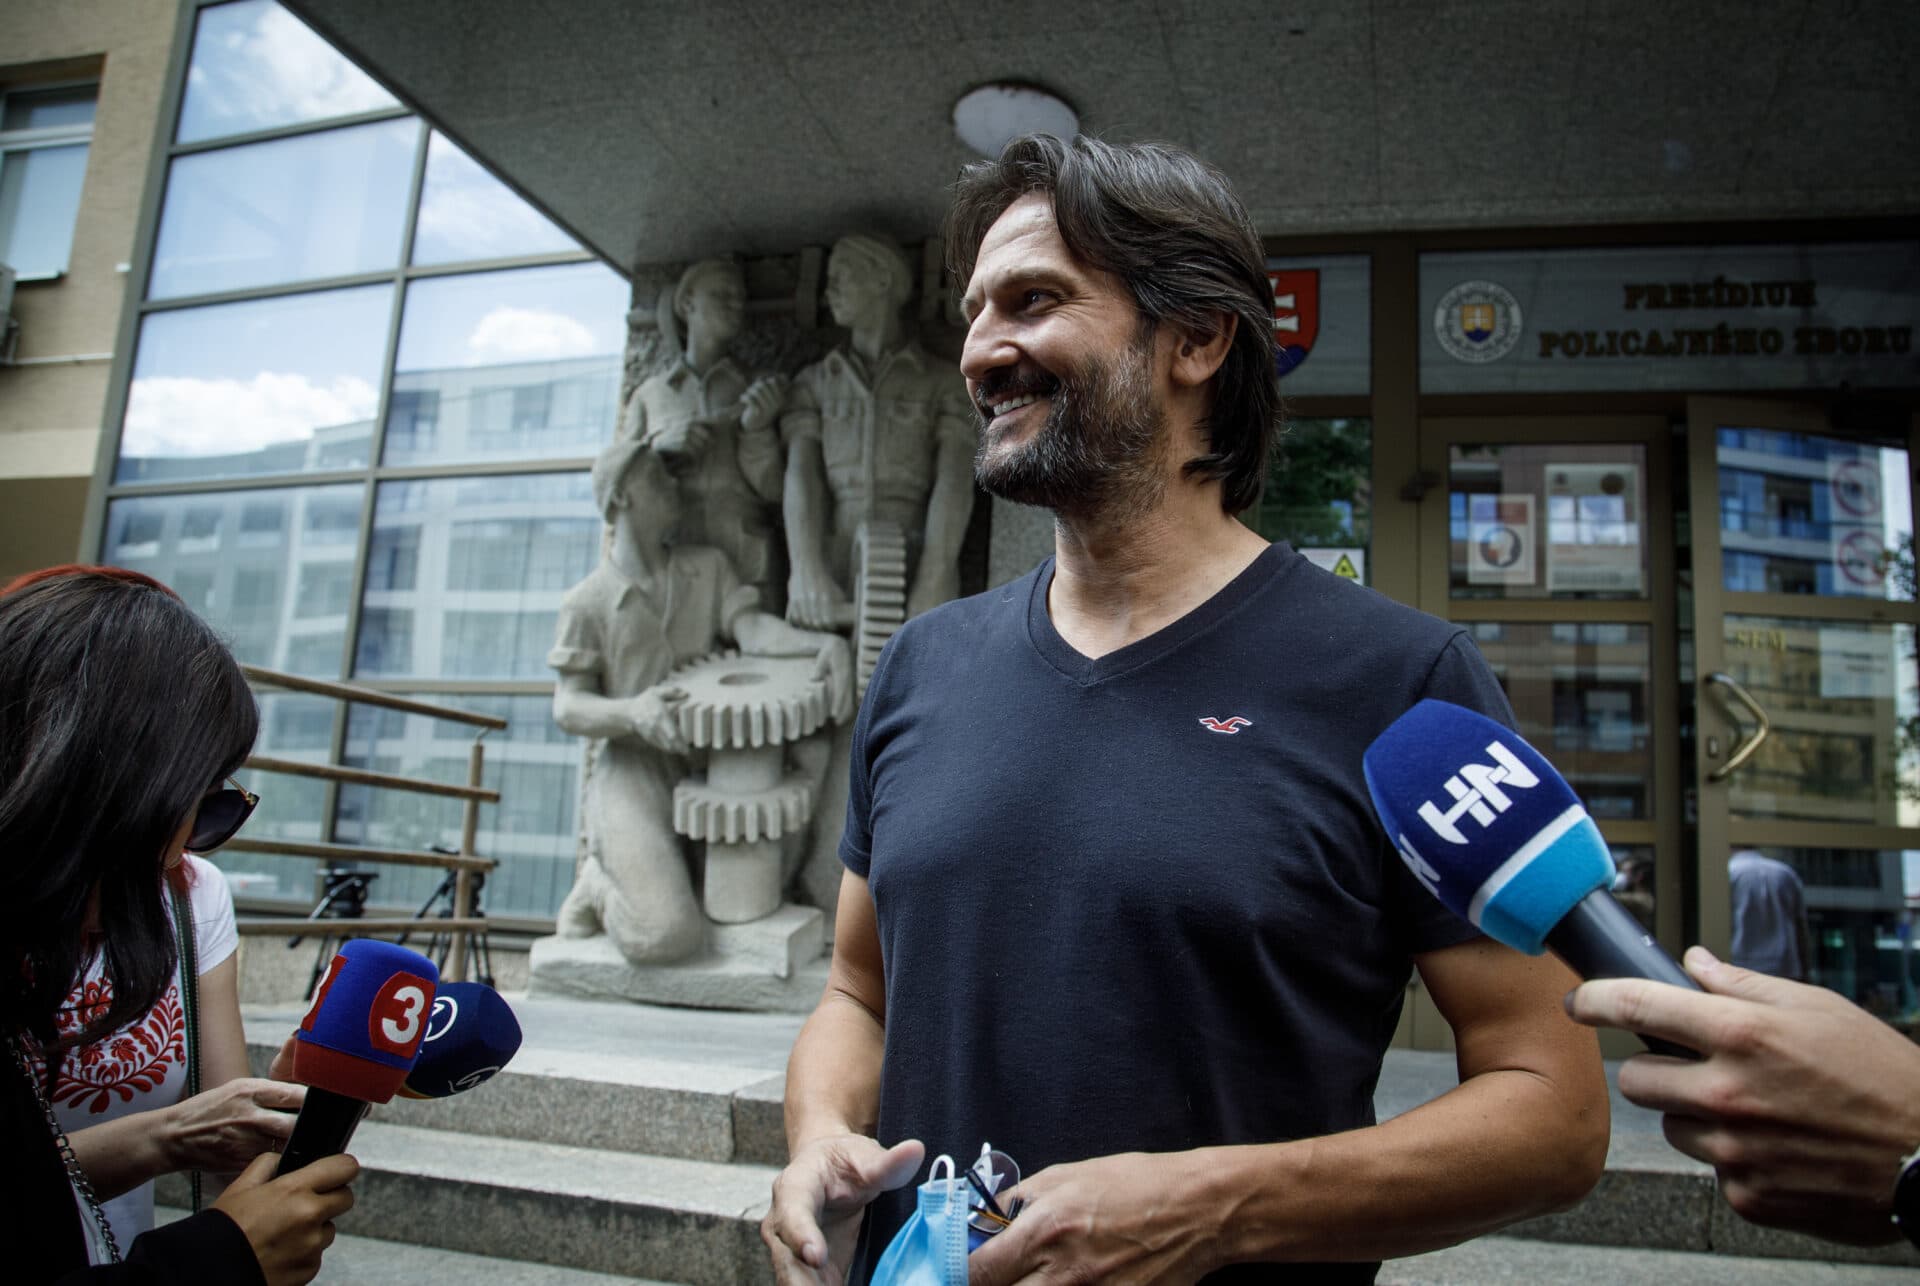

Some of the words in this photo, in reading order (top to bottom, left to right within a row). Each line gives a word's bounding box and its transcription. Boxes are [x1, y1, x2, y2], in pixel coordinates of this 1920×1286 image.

[1623, 276, 1817, 310] PREZÍDIUM
[1538, 322, 1784, 357] POLICAJNÉHO
[1794, 326, 1912, 356] ZBORU
[1417, 740, 1540, 844] HN
[382, 986, 425, 1044] 3
